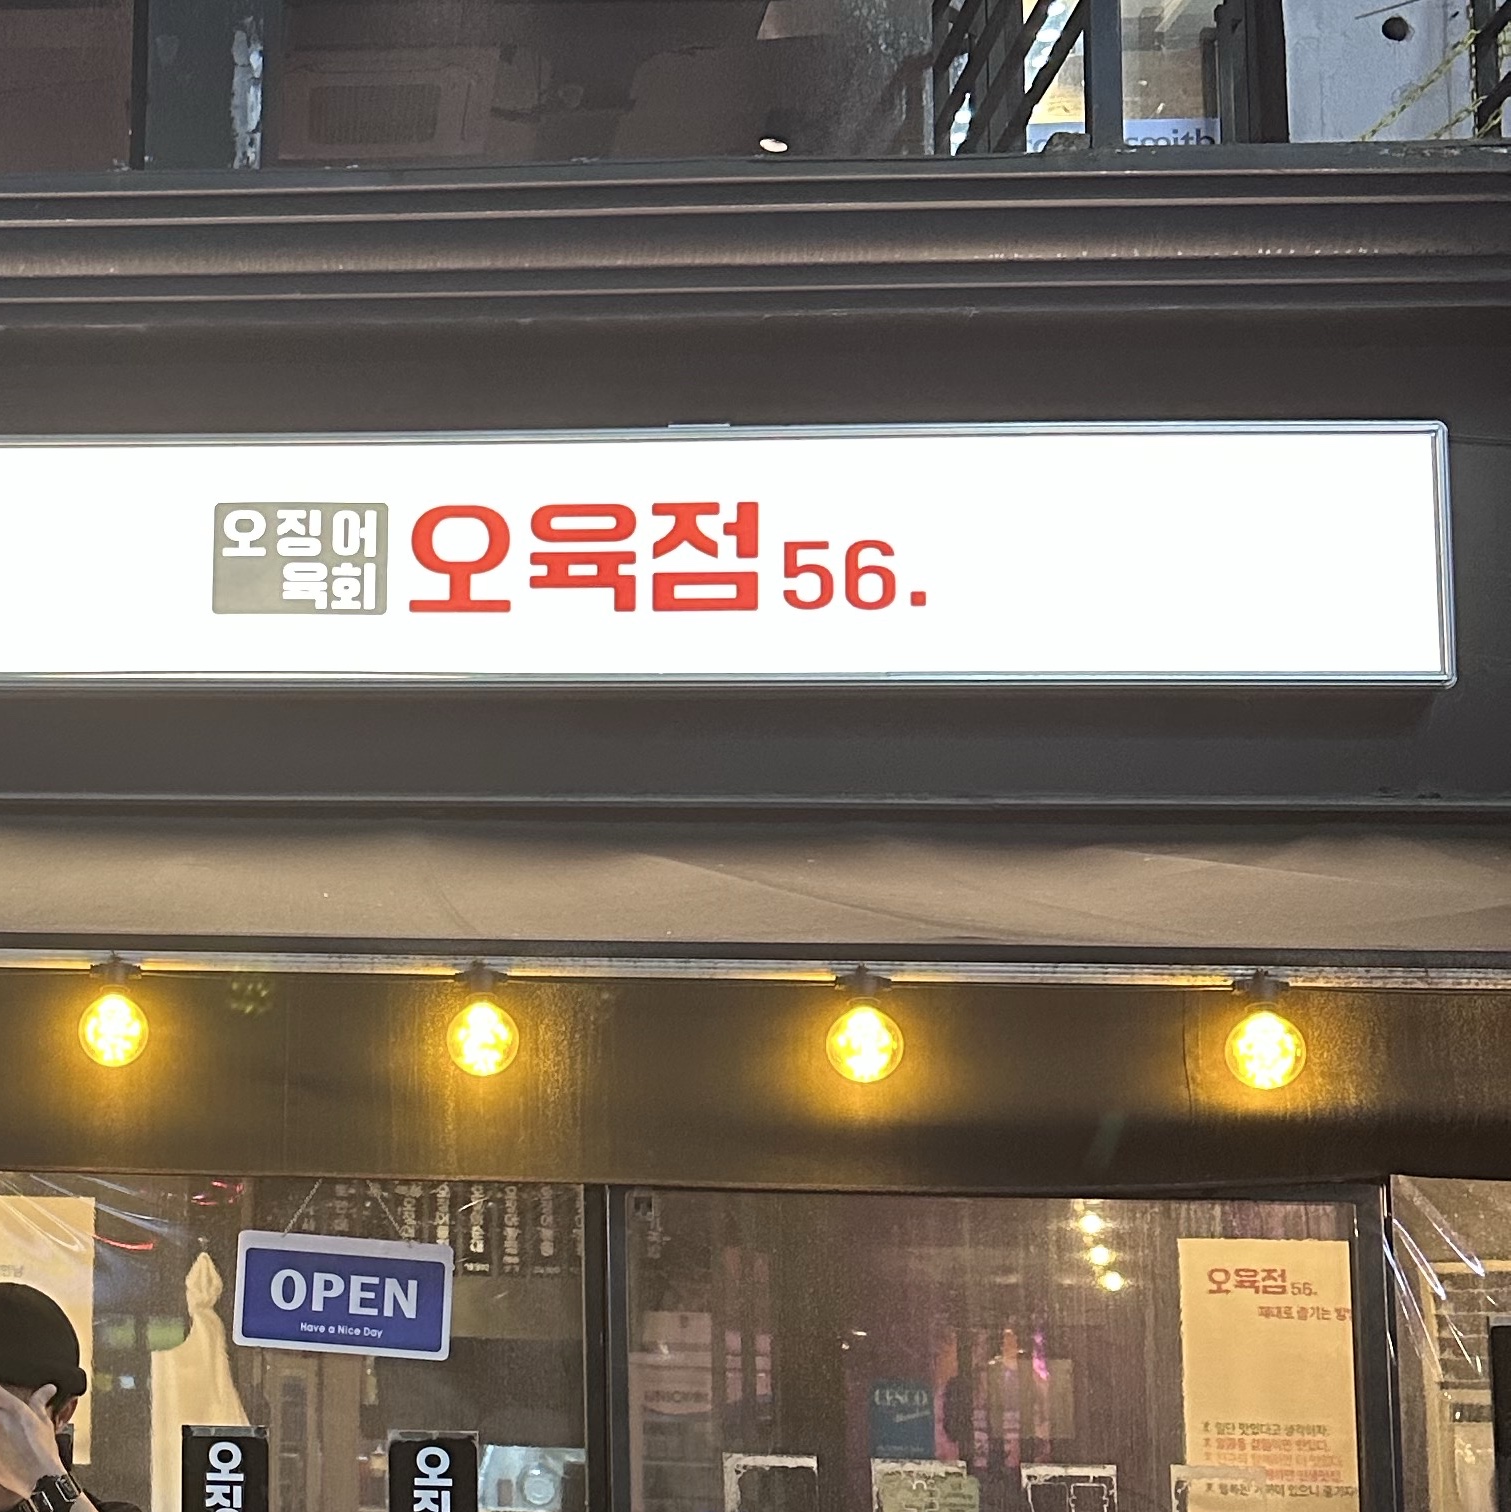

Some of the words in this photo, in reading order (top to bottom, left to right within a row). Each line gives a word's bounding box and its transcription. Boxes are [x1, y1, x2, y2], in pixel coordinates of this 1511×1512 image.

[221, 509, 377, 558] 오징어
[409, 501, 759, 613] 오육점
[282, 562, 377, 611] 육회
[270, 1269, 418, 1319] OPEN
[1335, 1306, 1352, 1321] 방
[300, 1322, 326, 1334] Have
[328, 1325, 335, 1334] a
[338, 1324, 361, 1336] Nice
[363, 1326, 383, 1339] Day
